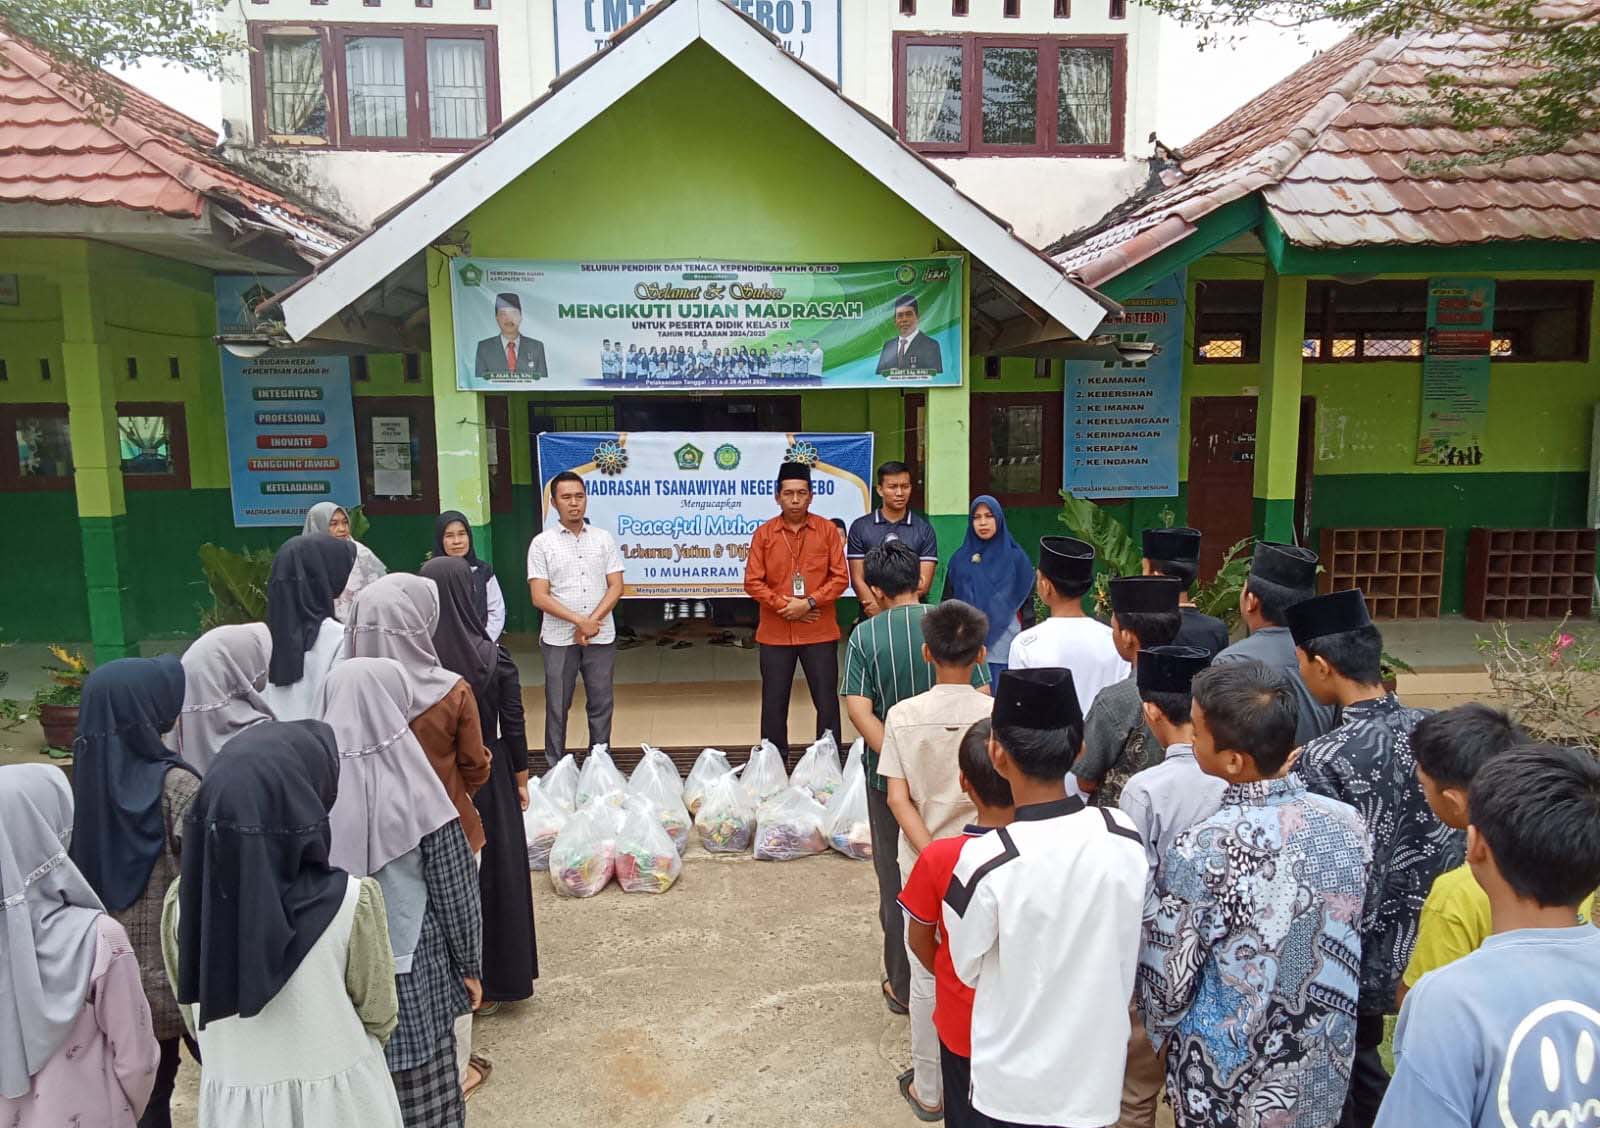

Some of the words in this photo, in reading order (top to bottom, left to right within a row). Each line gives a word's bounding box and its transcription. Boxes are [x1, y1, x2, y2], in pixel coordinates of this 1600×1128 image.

[581, 264, 619, 272] SELURUH
[622, 263, 662, 272] PENDIDIK
[664, 263, 682, 272] DAN
[685, 263, 719, 272] TENAGA
[721, 263, 782, 273] KEPENDIDIKAN
[815, 264, 839, 273] TEBO
[634, 282, 702, 300] Selamat
[729, 281, 786, 300] Sukses
[558, 303, 672, 319] MENGIKUTI
[678, 303, 738, 319] UJIAN
[745, 302, 862, 319] MADRASAH
[1134, 312, 1160, 323] TEBO
[631, 321, 666, 330] UNTUK
[668, 321, 712, 330] PESERTA
[715, 321, 743, 330] DIDIK
[745, 320, 777, 330] KELAS
[780, 320, 790, 329] IX
[1087, 376, 1146, 385] KEAMANAN
[258, 389, 319, 399] INTEGRITAS
[1087, 390, 1153, 398] KEBERSIHAN
[259, 413, 321, 423] PROFESIONAL
[1086, 417, 1170, 425] KEKELUARGAAN
[1086, 431, 1161, 439] KERINDANGAN
[271, 437, 313, 447] INOVATIF
[1086, 444, 1138, 452] KERAPIAN
[252, 460, 302, 469] TANGGUNG
[304, 459, 336, 468] JAWAB
[266, 483, 325, 493] KETELADANAN
[655, 479, 736, 496] TSANAWIYAH
[741, 480, 778, 495] NEGE
[680, 498, 742, 510] Mengucapkan
[618, 514, 702, 539] Peaceful
[620, 543, 673, 559] Lebaran
[673, 543, 711, 563] Yatim
[726, 543, 752, 562] Dif
[644, 567, 656, 577] 10
[660, 567, 739, 577] MUHARRAM
